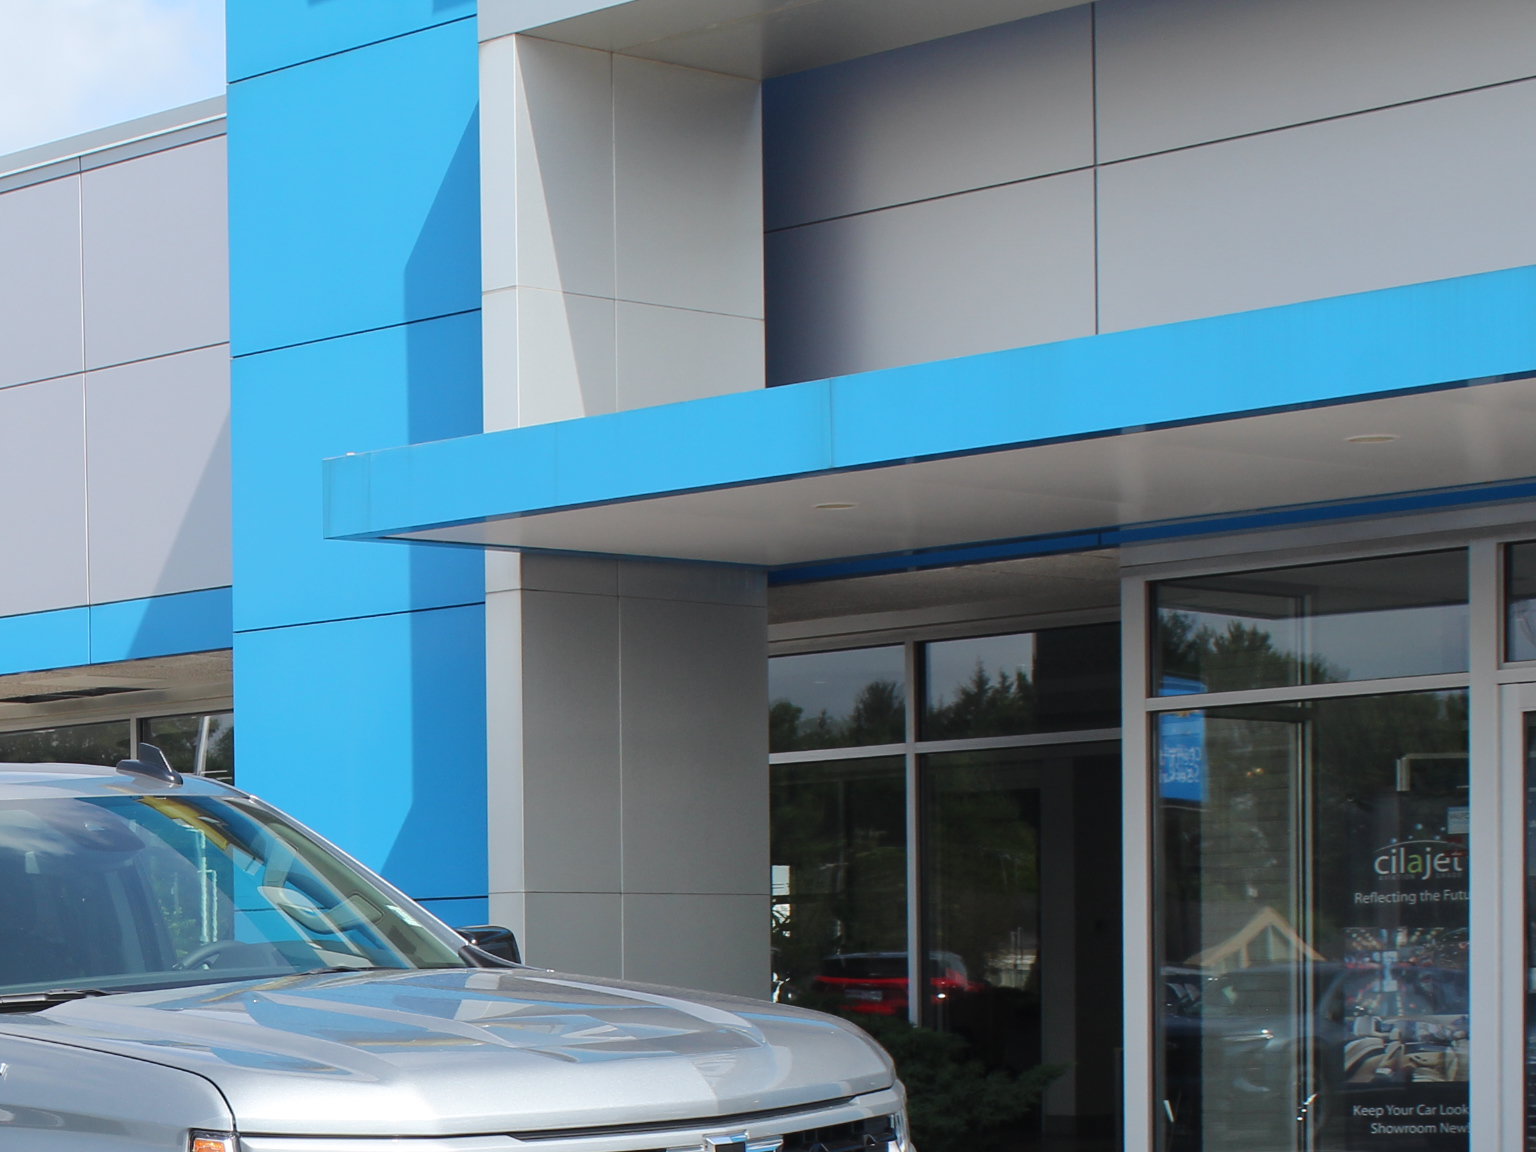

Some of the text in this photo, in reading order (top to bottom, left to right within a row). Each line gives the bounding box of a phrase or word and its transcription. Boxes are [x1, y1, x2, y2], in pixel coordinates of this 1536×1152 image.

[1374, 847, 1464, 880] cilajet
[1353, 891, 1417, 904] Reflecting
[1419, 889, 1441, 902] the
[1352, 1104, 1470, 1118] Keep Your Car Look
[1370, 1122, 1437, 1134] Showroom
